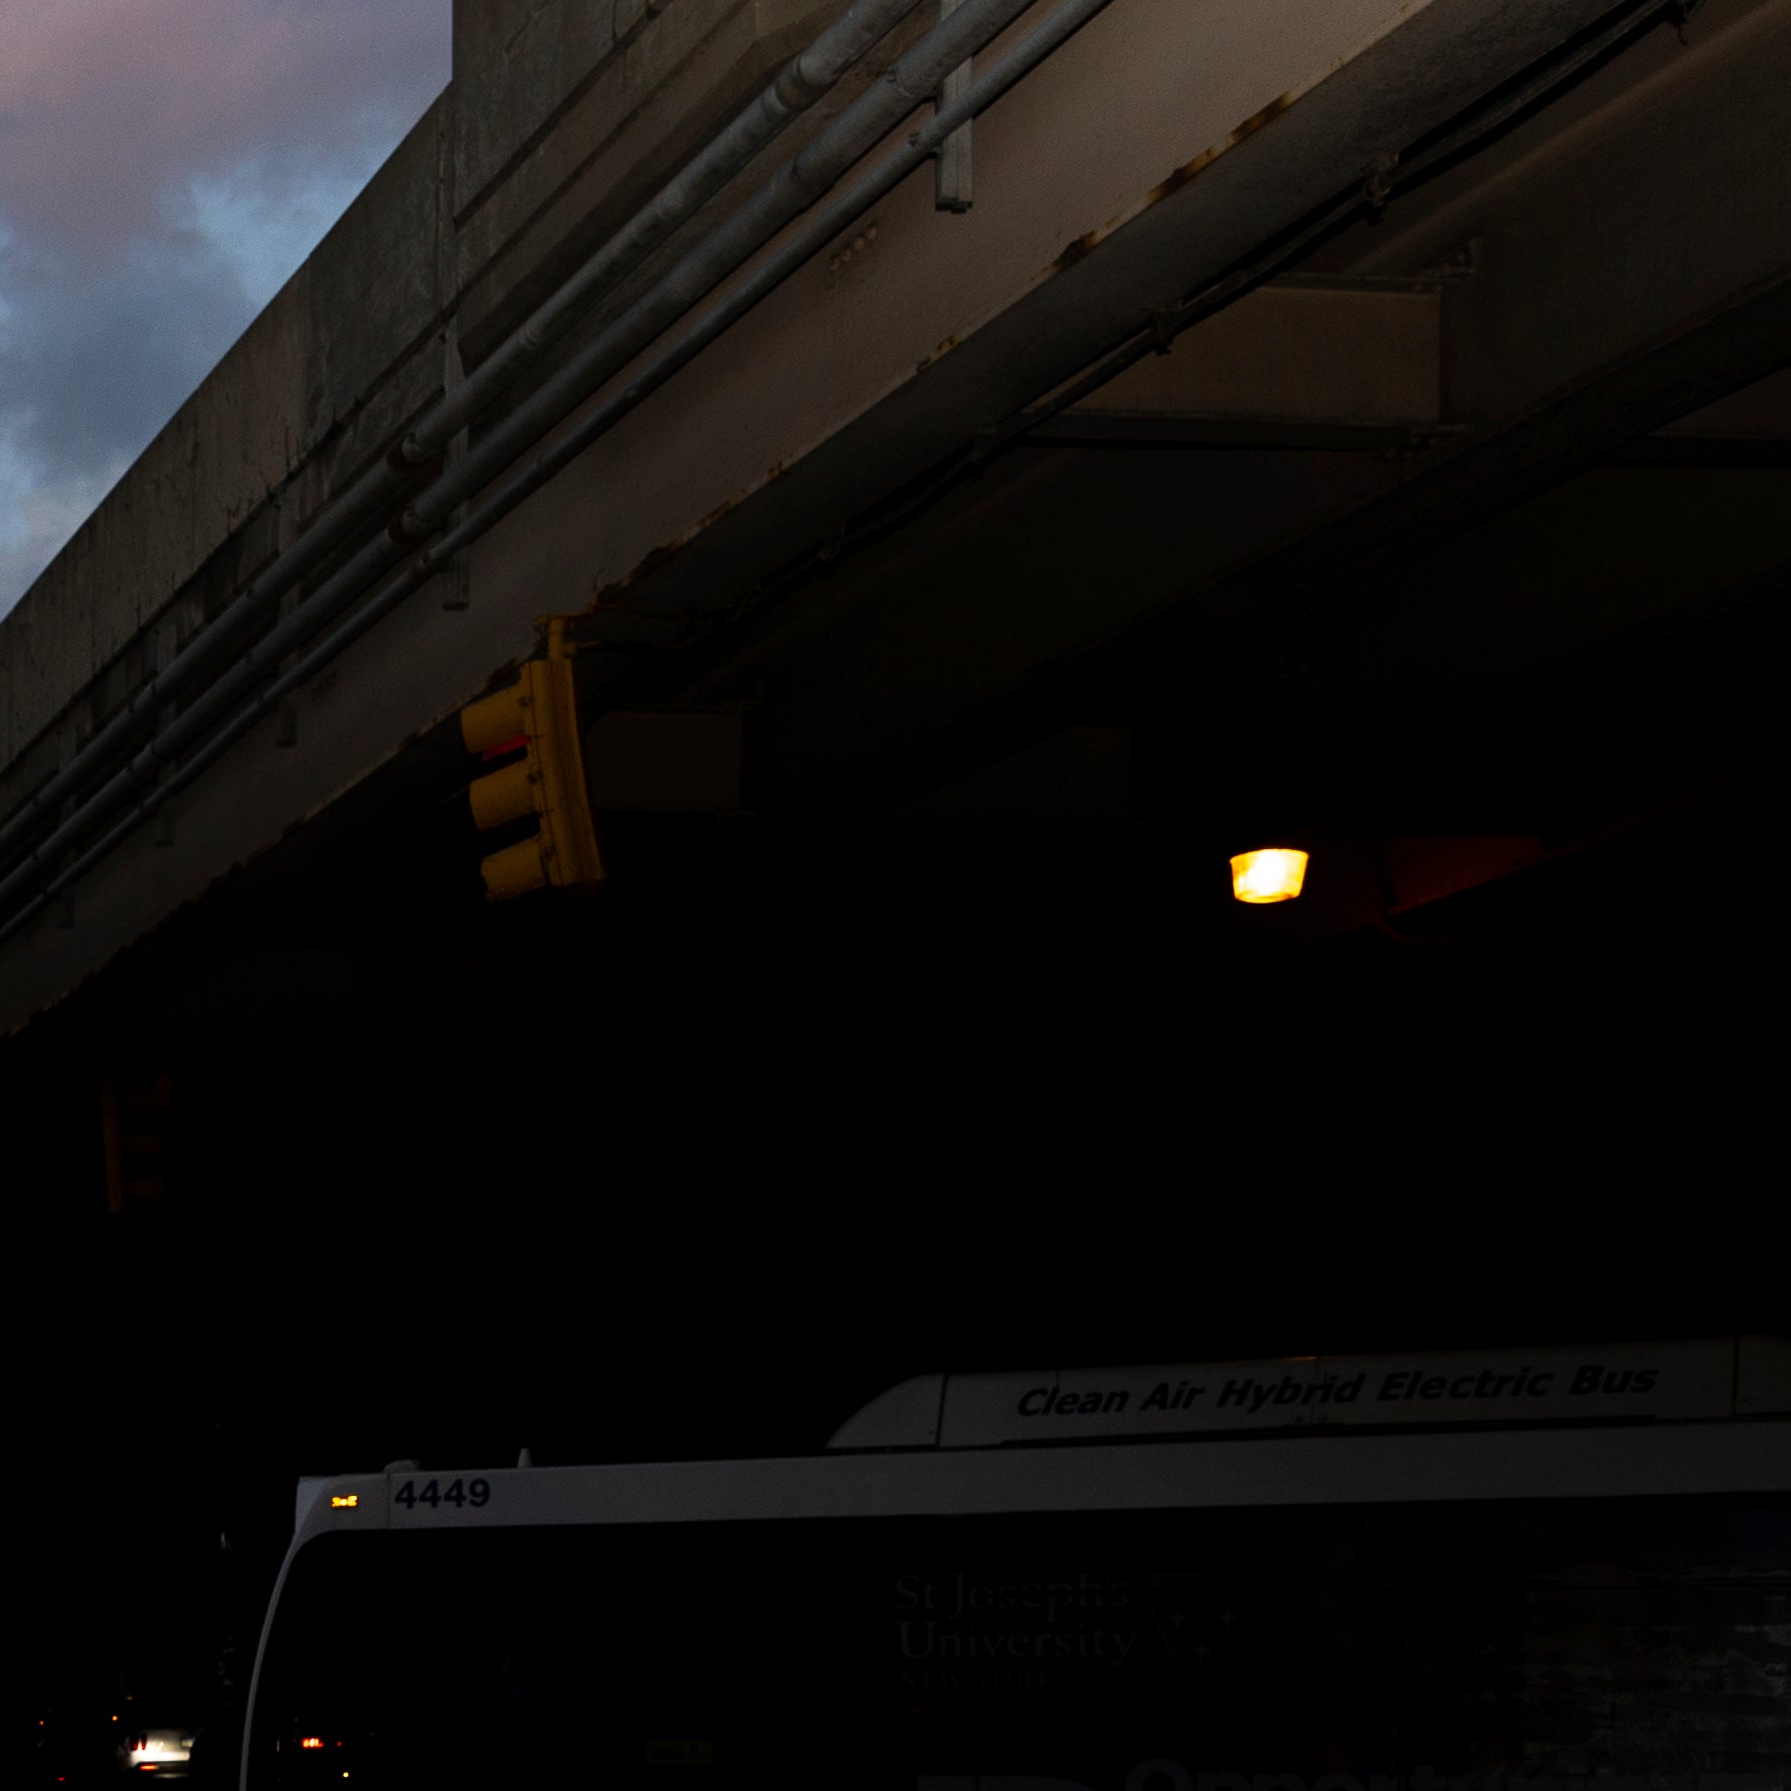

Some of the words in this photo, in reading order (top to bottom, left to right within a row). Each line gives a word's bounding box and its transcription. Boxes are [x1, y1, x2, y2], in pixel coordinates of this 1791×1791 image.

[1017, 1387, 1129, 1417] Clean
[1140, 1383, 1205, 1411] Air
[1217, 1371, 1362, 1411] Hybrid
[1377, 1366, 1550, 1403] Electric
[1570, 1364, 1660, 1395] Bus
[394, 1477, 491, 1509] 4449
[897, 1620, 1139, 1668] University
